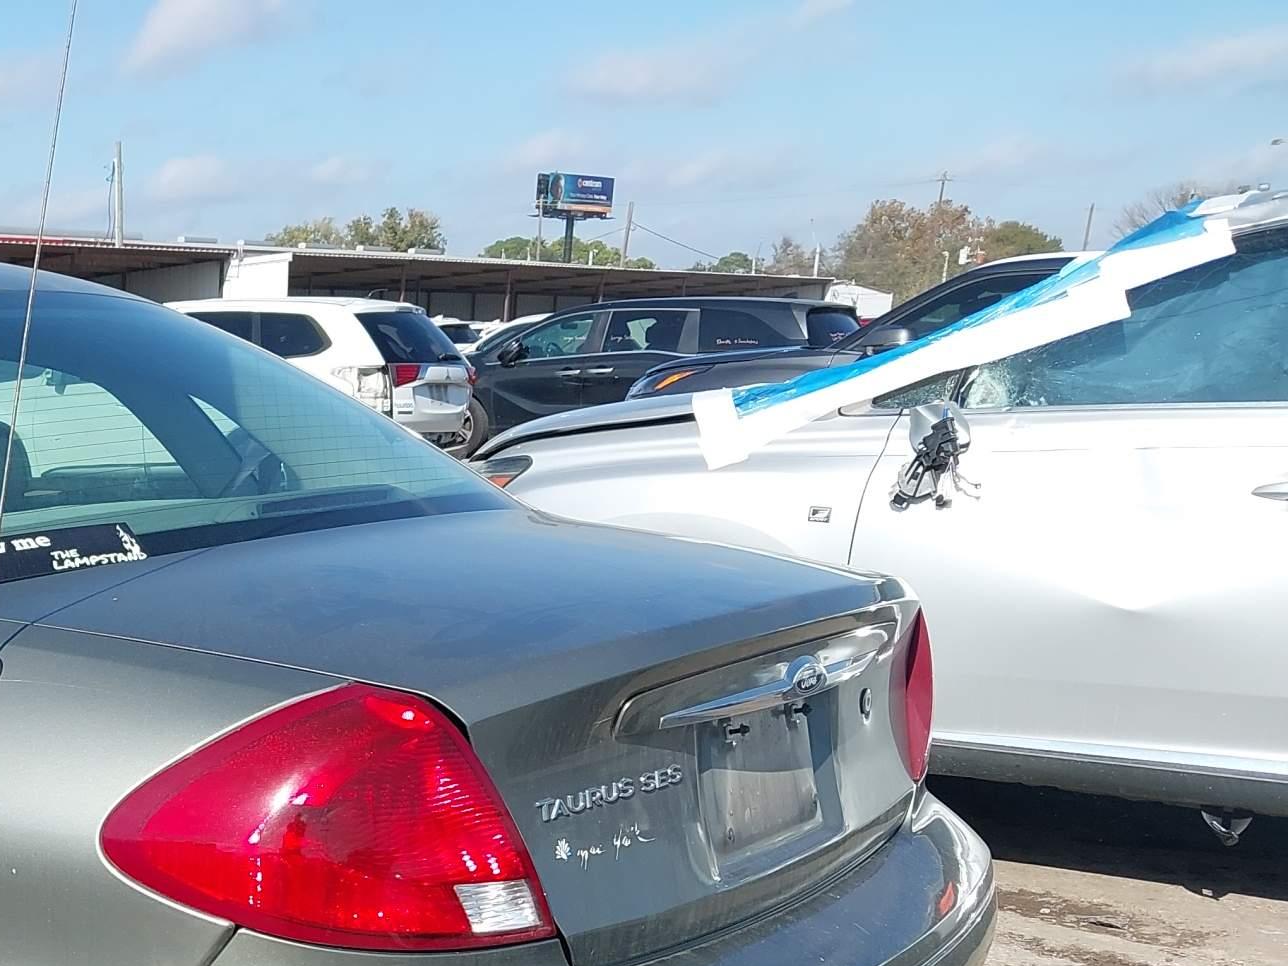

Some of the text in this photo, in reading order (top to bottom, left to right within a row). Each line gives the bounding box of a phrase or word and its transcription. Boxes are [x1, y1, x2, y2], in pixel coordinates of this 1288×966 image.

[11, 534, 51, 551] me
[50, 548, 80, 560] THE
[52, 551, 148, 571] LAMPSTAND
[535, 763, 683, 822] TAURUS SES
